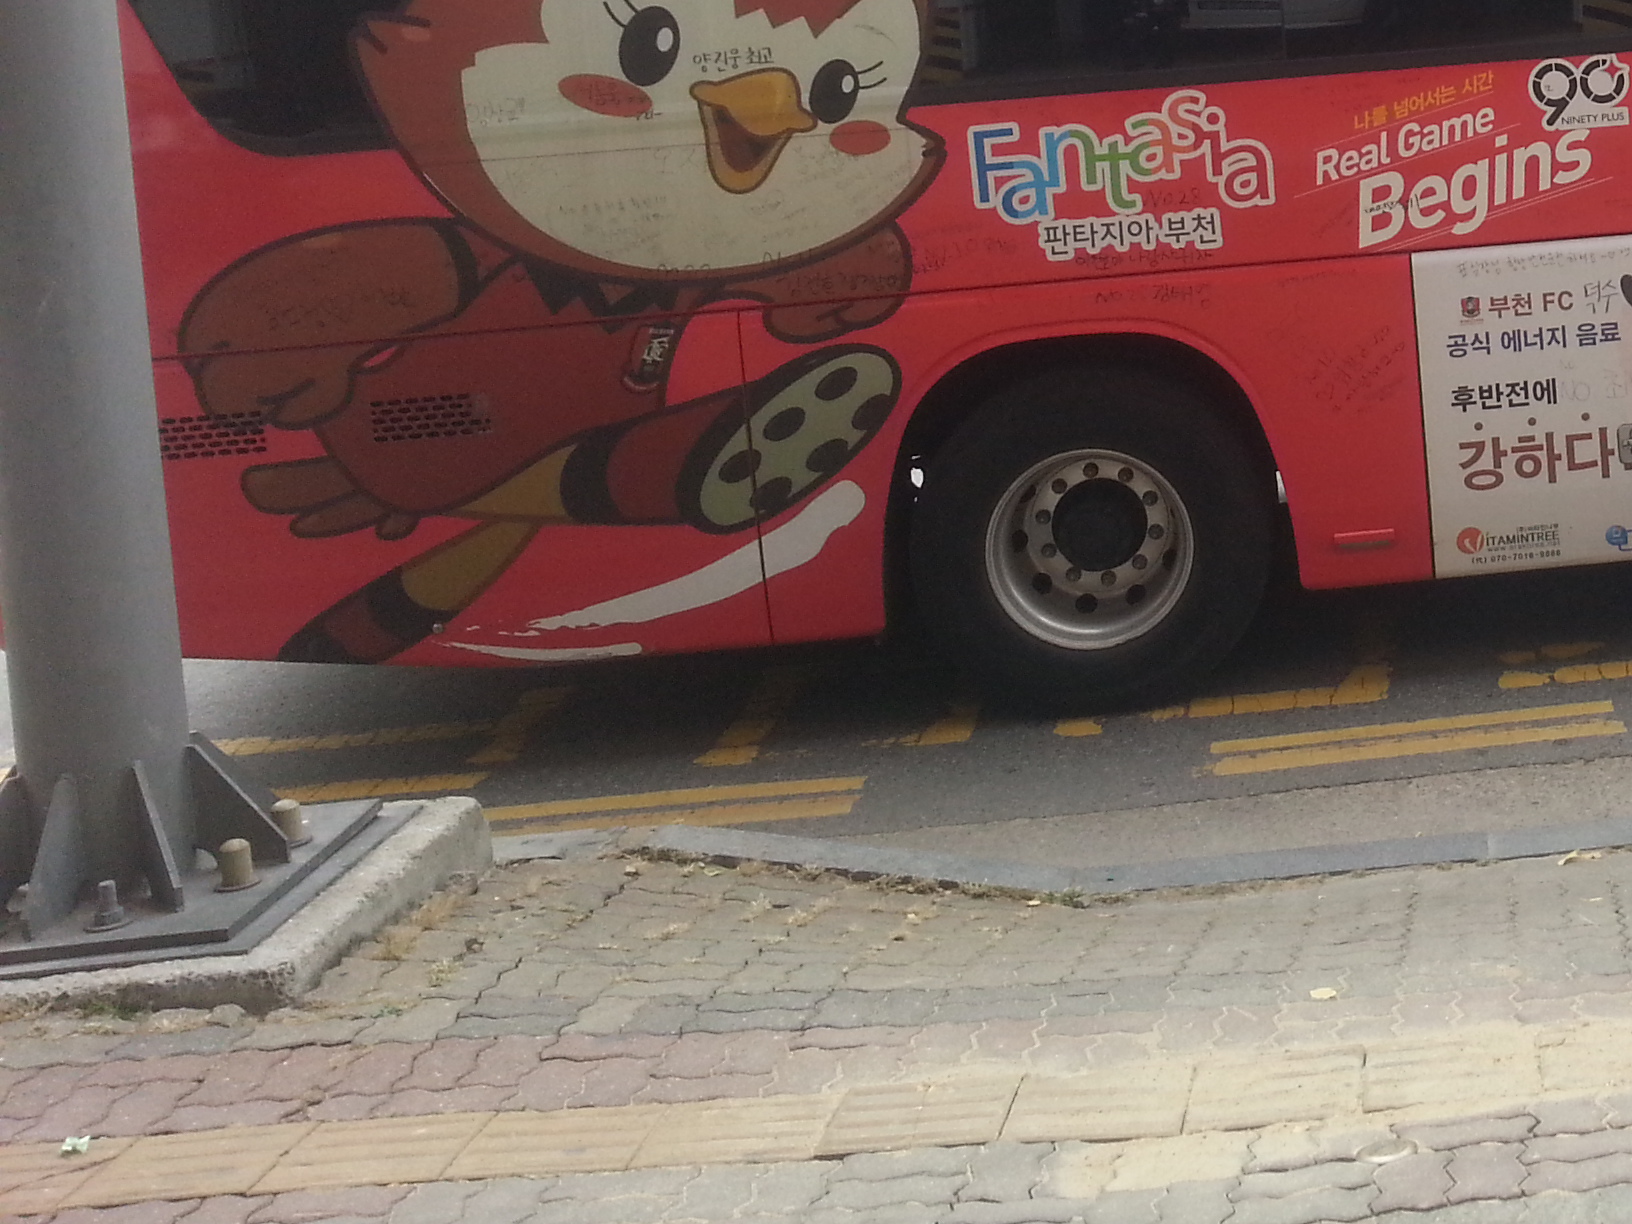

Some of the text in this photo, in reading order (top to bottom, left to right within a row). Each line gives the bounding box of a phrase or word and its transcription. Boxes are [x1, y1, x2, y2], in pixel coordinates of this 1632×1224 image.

[1354, 72, 1495, 130] 나를 넘어서는 시간
[1561, 111, 1625, 125] NINETY PLUS
[968, 90, 1275, 224] Fantasia
[1316, 105, 1496, 186] Real Game
[1358, 128, 1593, 249] Begins
[1043, 216, 1158, 256] 판타지아
[1164, 213, 1220, 248] 부천
[1488, 290, 1574, 318] 부천 FC
[1446, 321, 1622, 358] 공식 에너지 음료
[1450, 378, 1558, 413] 후반전에
[1457, 425, 1632, 492] 강하다
